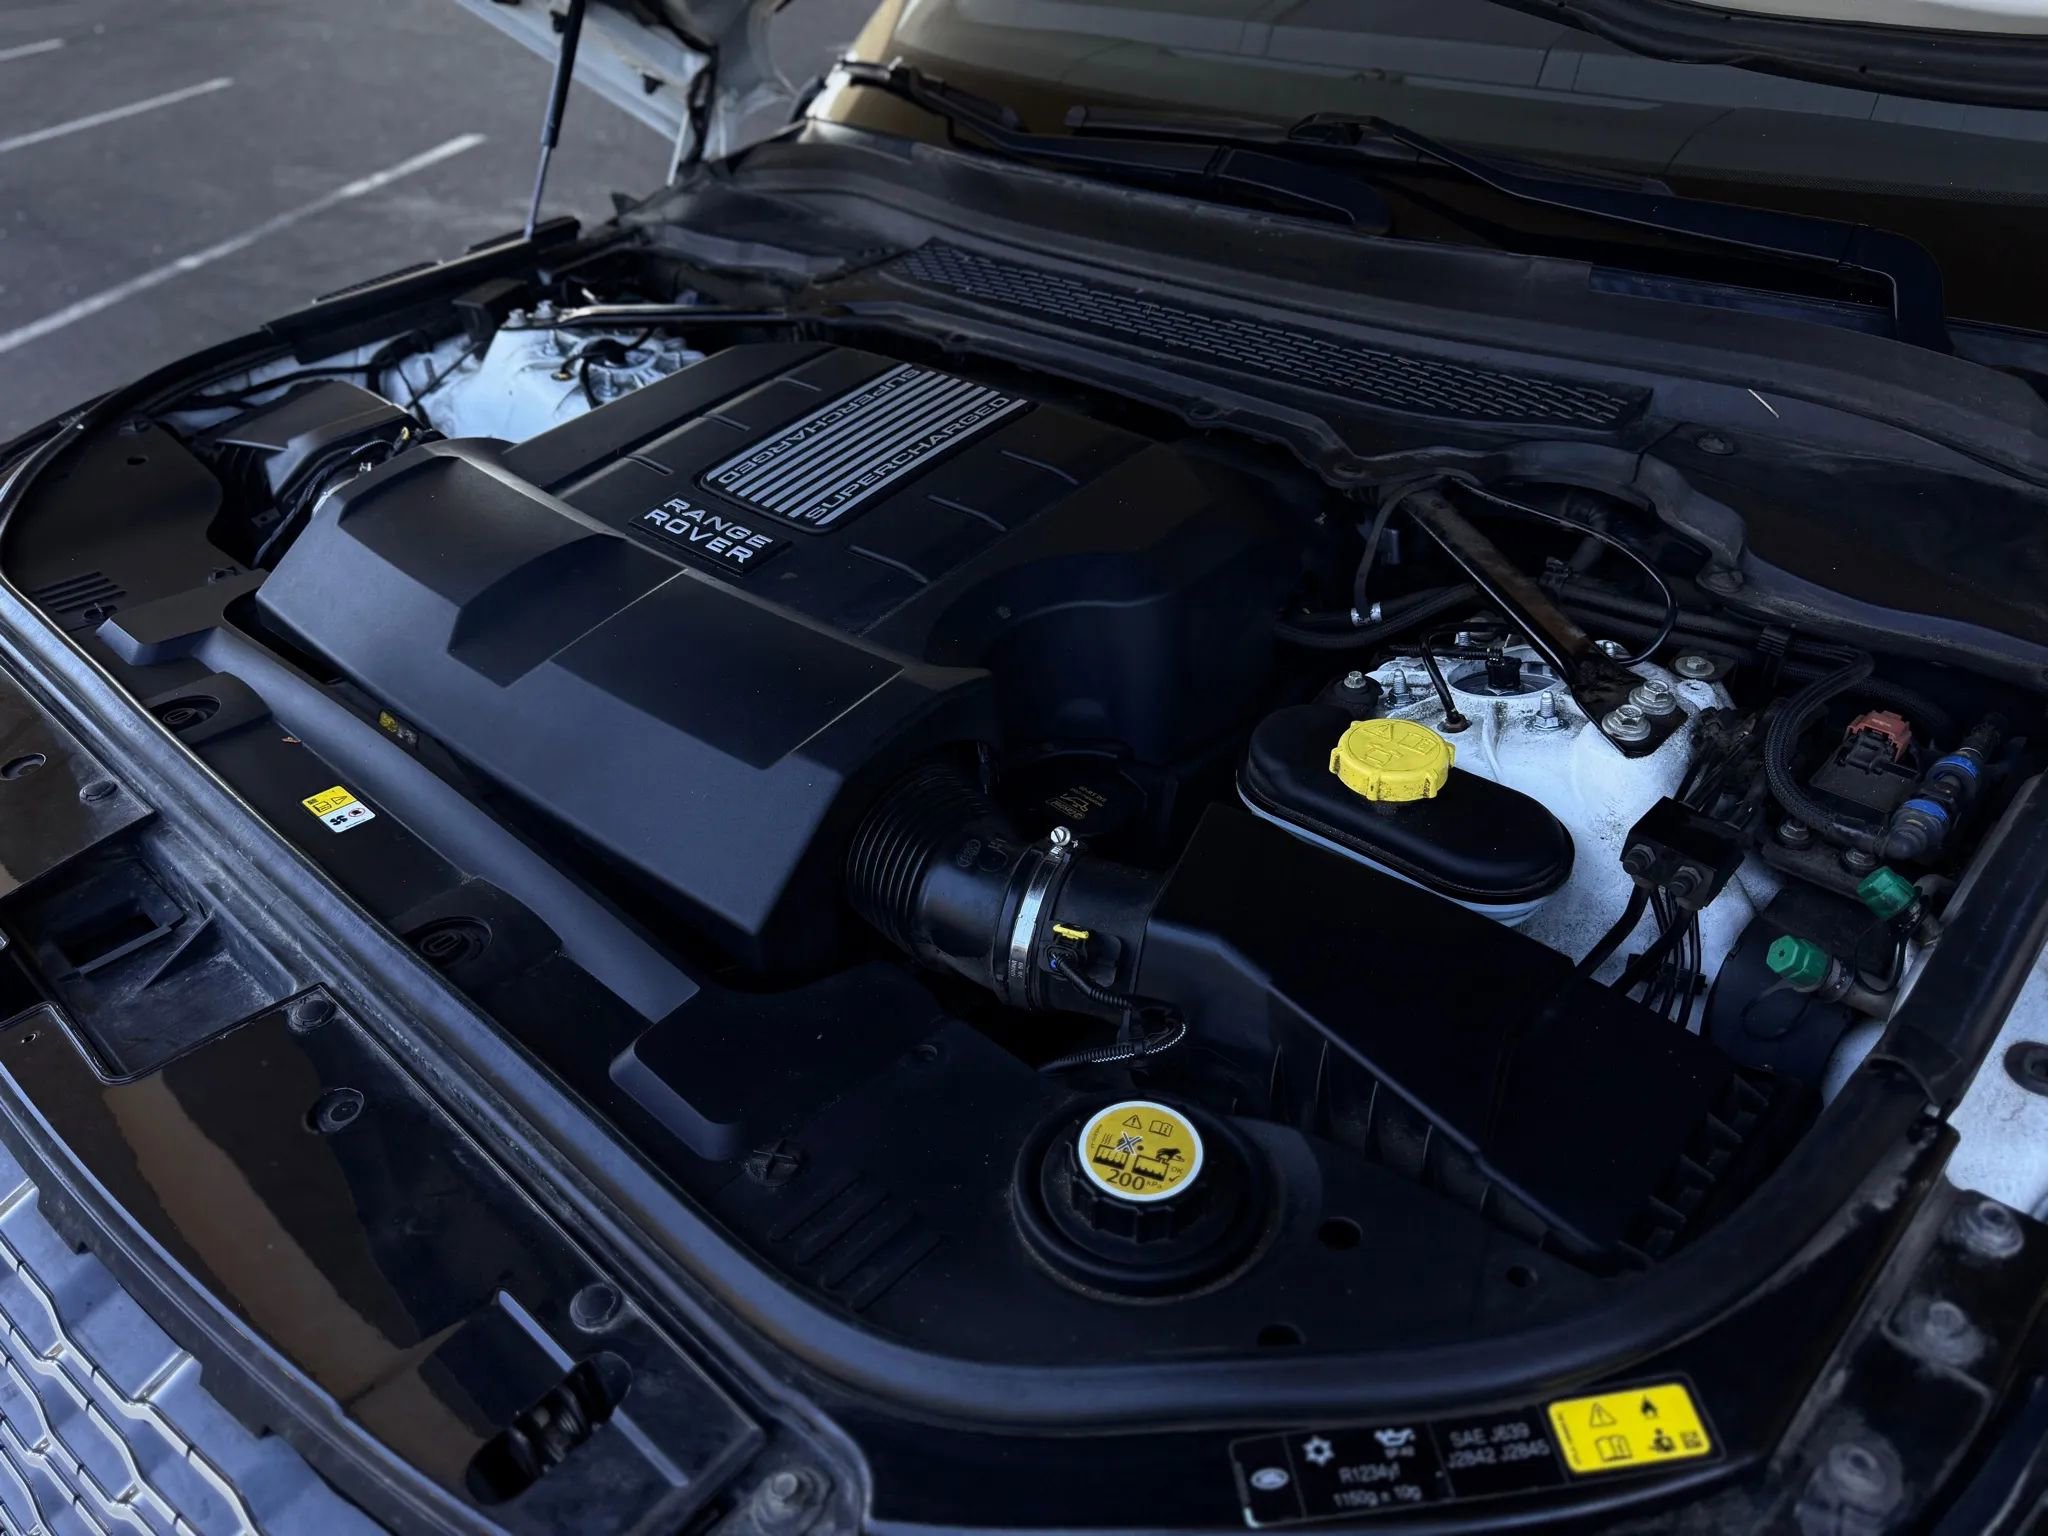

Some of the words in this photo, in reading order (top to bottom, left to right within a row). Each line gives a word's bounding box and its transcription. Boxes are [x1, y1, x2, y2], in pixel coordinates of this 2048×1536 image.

[718, 369, 921, 485] SUPERCHARGED
[804, 397, 1010, 522] SUPERCHARGED
[644, 509, 754, 564] ROVER
[663, 497, 774, 550] RANGE
[1106, 1168, 1146, 1191] 200
[1449, 1427, 1488, 1449] SAE
